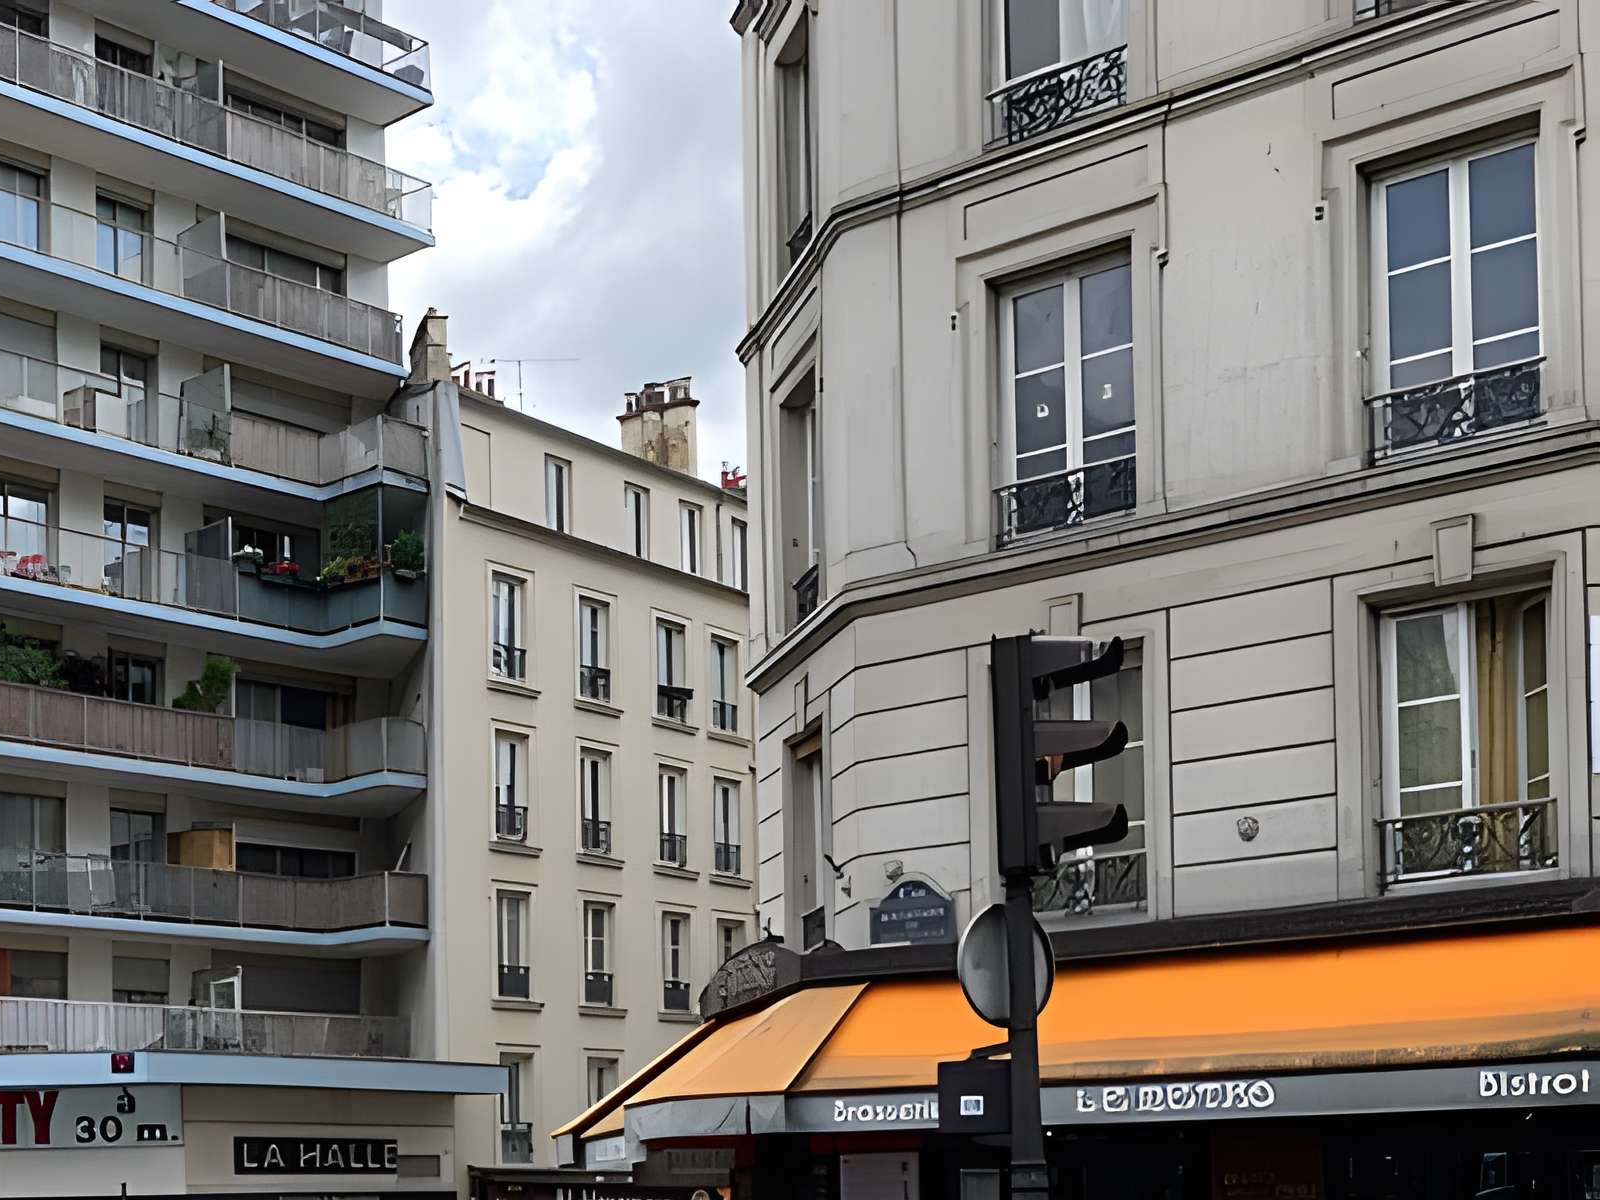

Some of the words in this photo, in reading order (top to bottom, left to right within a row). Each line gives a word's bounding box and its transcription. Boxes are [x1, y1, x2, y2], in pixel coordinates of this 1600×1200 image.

[75, 1115, 123, 1144] 30
[243, 1143, 286, 1168] LA
[299, 1143, 398, 1168] HALLE
